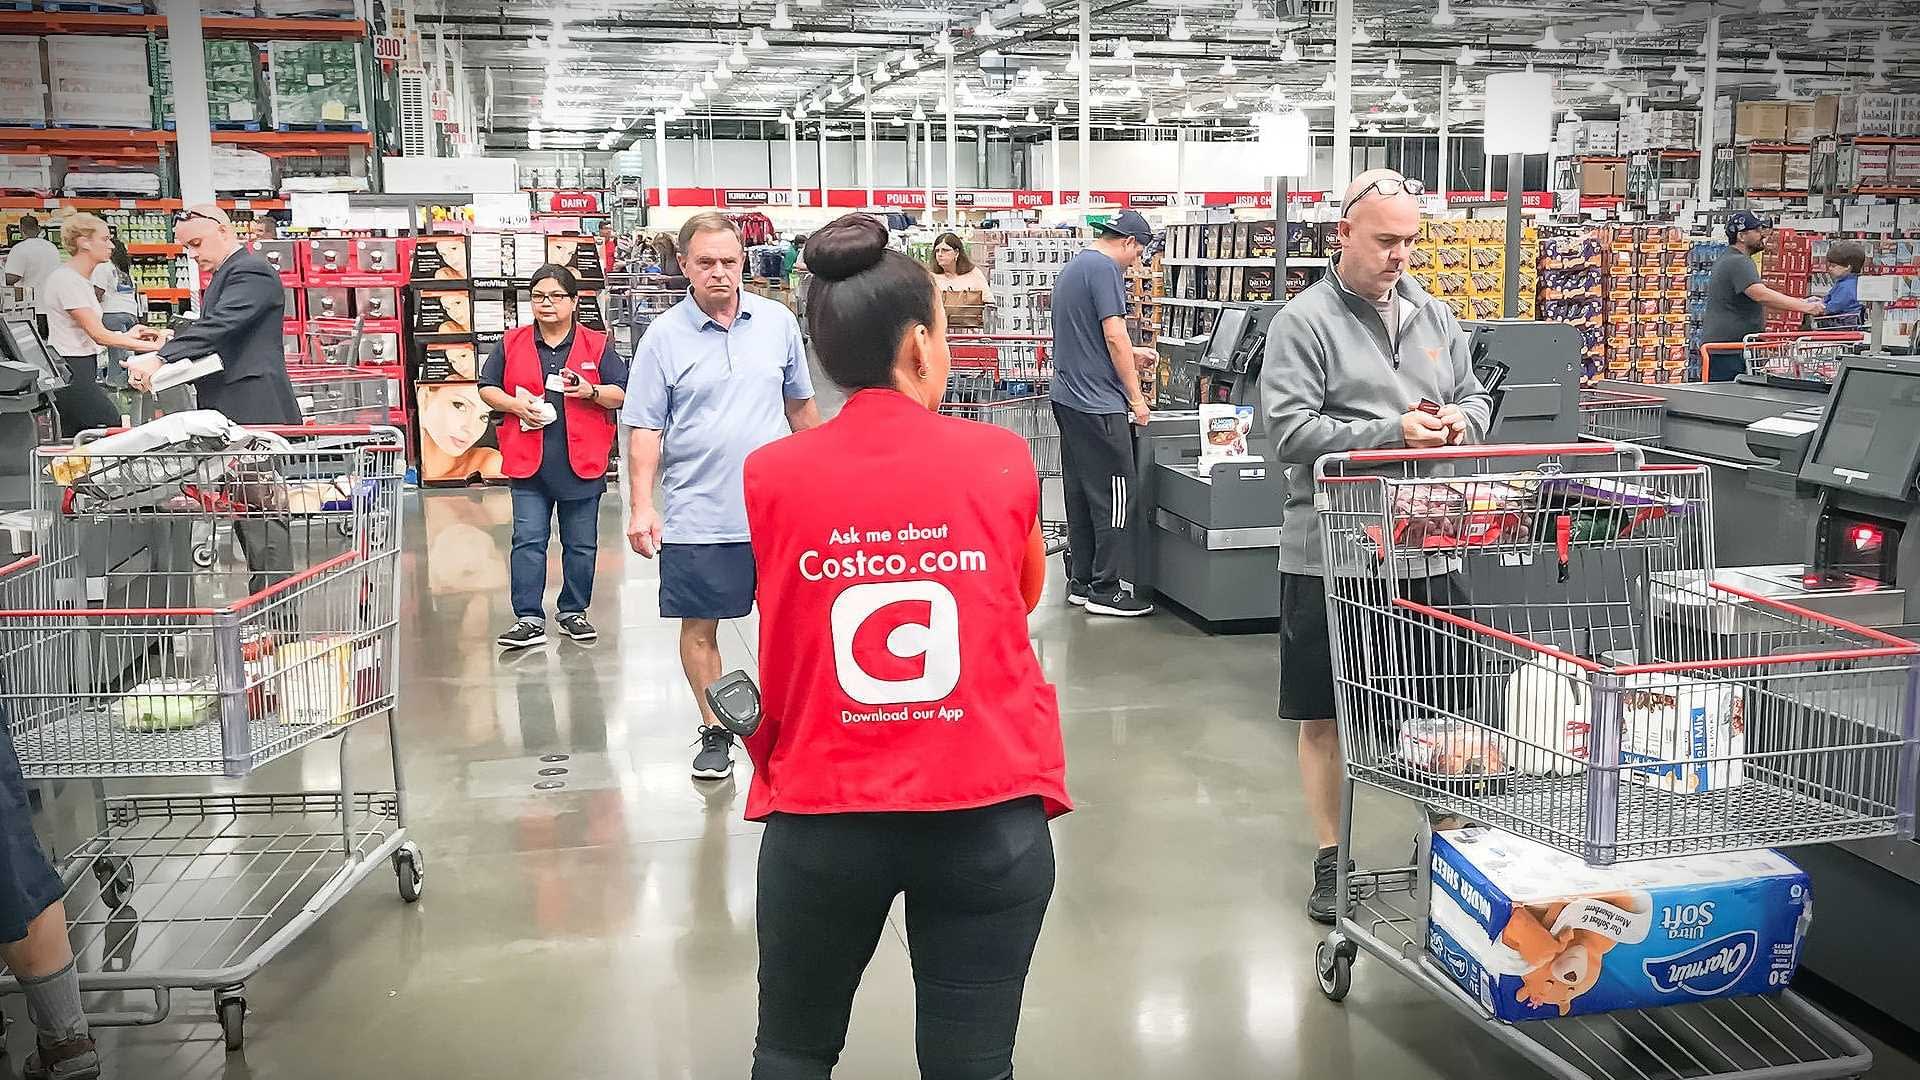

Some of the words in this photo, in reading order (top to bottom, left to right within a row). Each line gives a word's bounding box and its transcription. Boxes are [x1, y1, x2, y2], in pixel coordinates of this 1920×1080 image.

[376, 38, 401, 57] 300
[561, 199, 589, 208] DAIRY
[1018, 194, 1043, 205] PORK
[1235, 195, 1258, 206] USDA
[473, 279, 509, 288] SeroVital
[829, 526, 861, 545] Ask
[866, 532, 892, 543] me
[897, 523, 949, 542] about
[799, 549, 987, 581] Costco.com
[841, 707, 909, 724] Download
[912, 709, 935, 720] our
[937, 706, 964, 722] App
[1431, 850, 1459, 891] SHEET
[1589, 915, 1610, 931] Softest
[1615, 914, 1632, 928] Most
[1662, 901, 1716, 930] Soft
[1610, 924, 1622, 936] Our
[1668, 926, 1704, 940] Ultra
[1668, 941, 1748, 983] Charmin
[1768, 969, 1790, 986] 30
